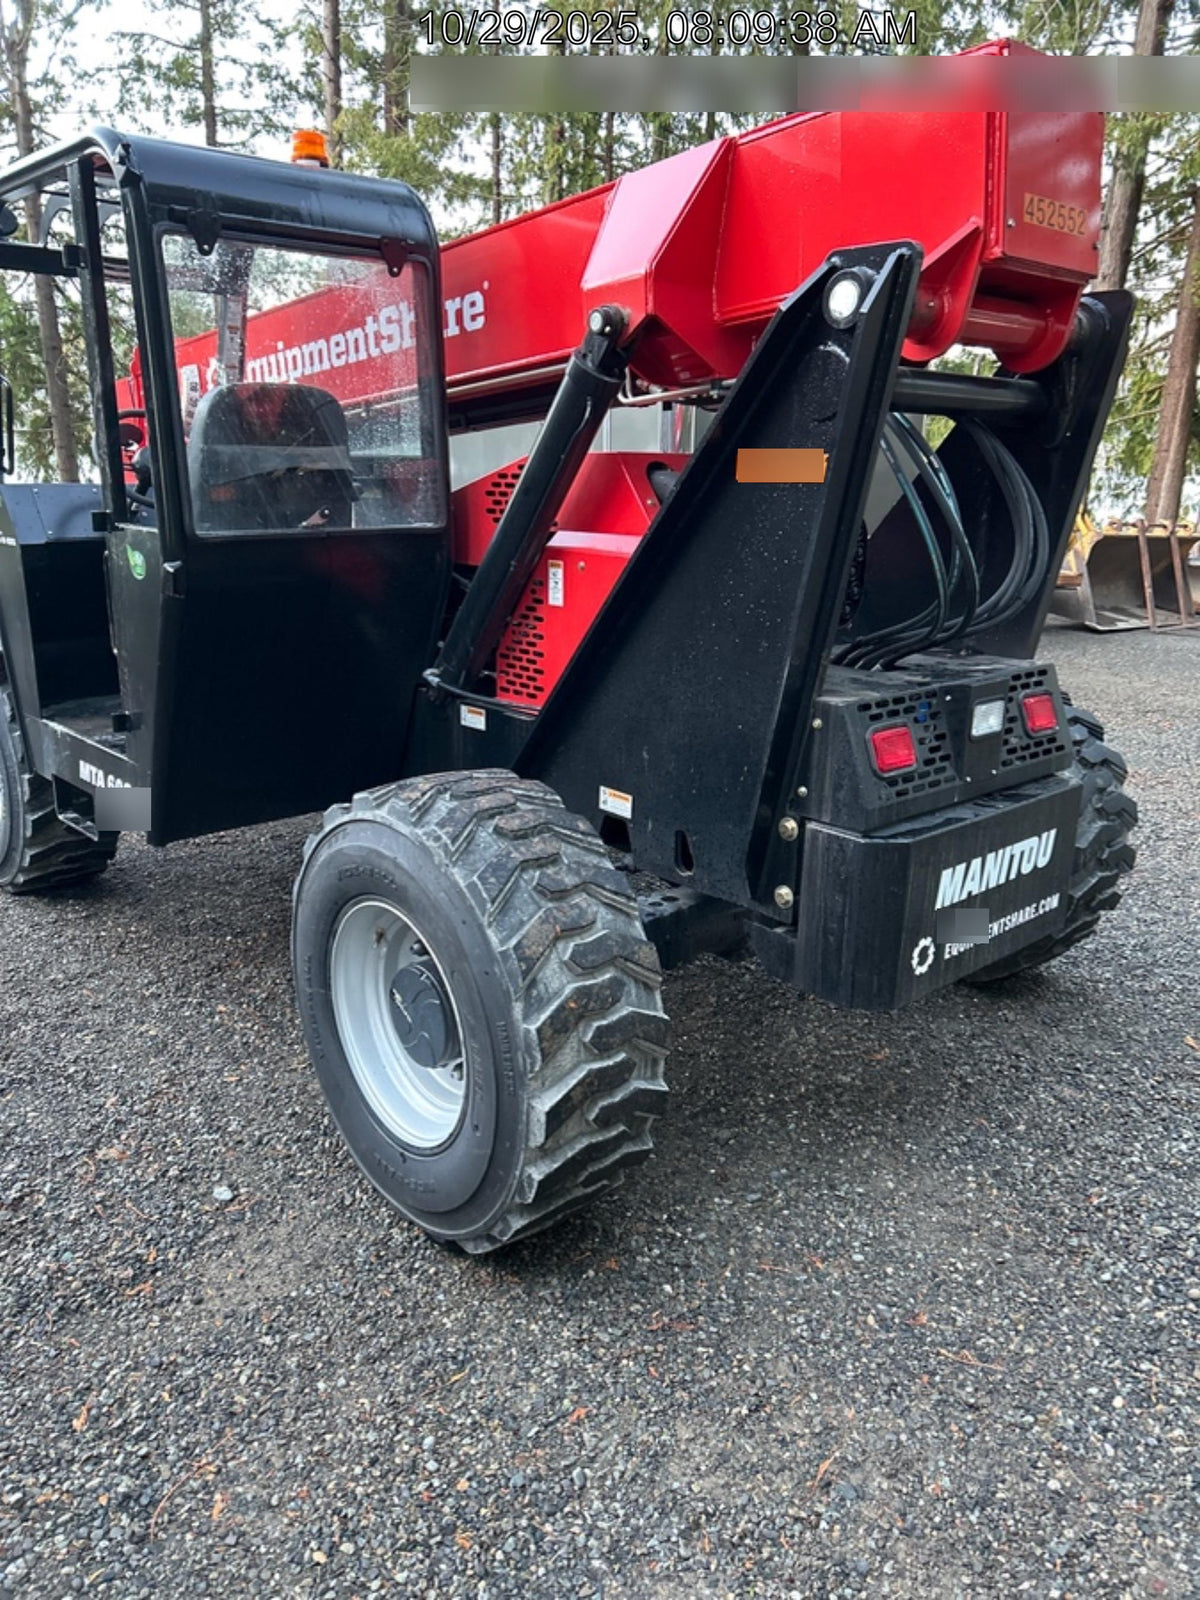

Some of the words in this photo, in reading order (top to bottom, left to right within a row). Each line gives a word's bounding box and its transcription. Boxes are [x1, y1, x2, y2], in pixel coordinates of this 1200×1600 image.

[1025, 196, 1087, 236] 452552
[79, 759, 105, 788] MTA
[935, 827, 1058, 911] MANITOU
